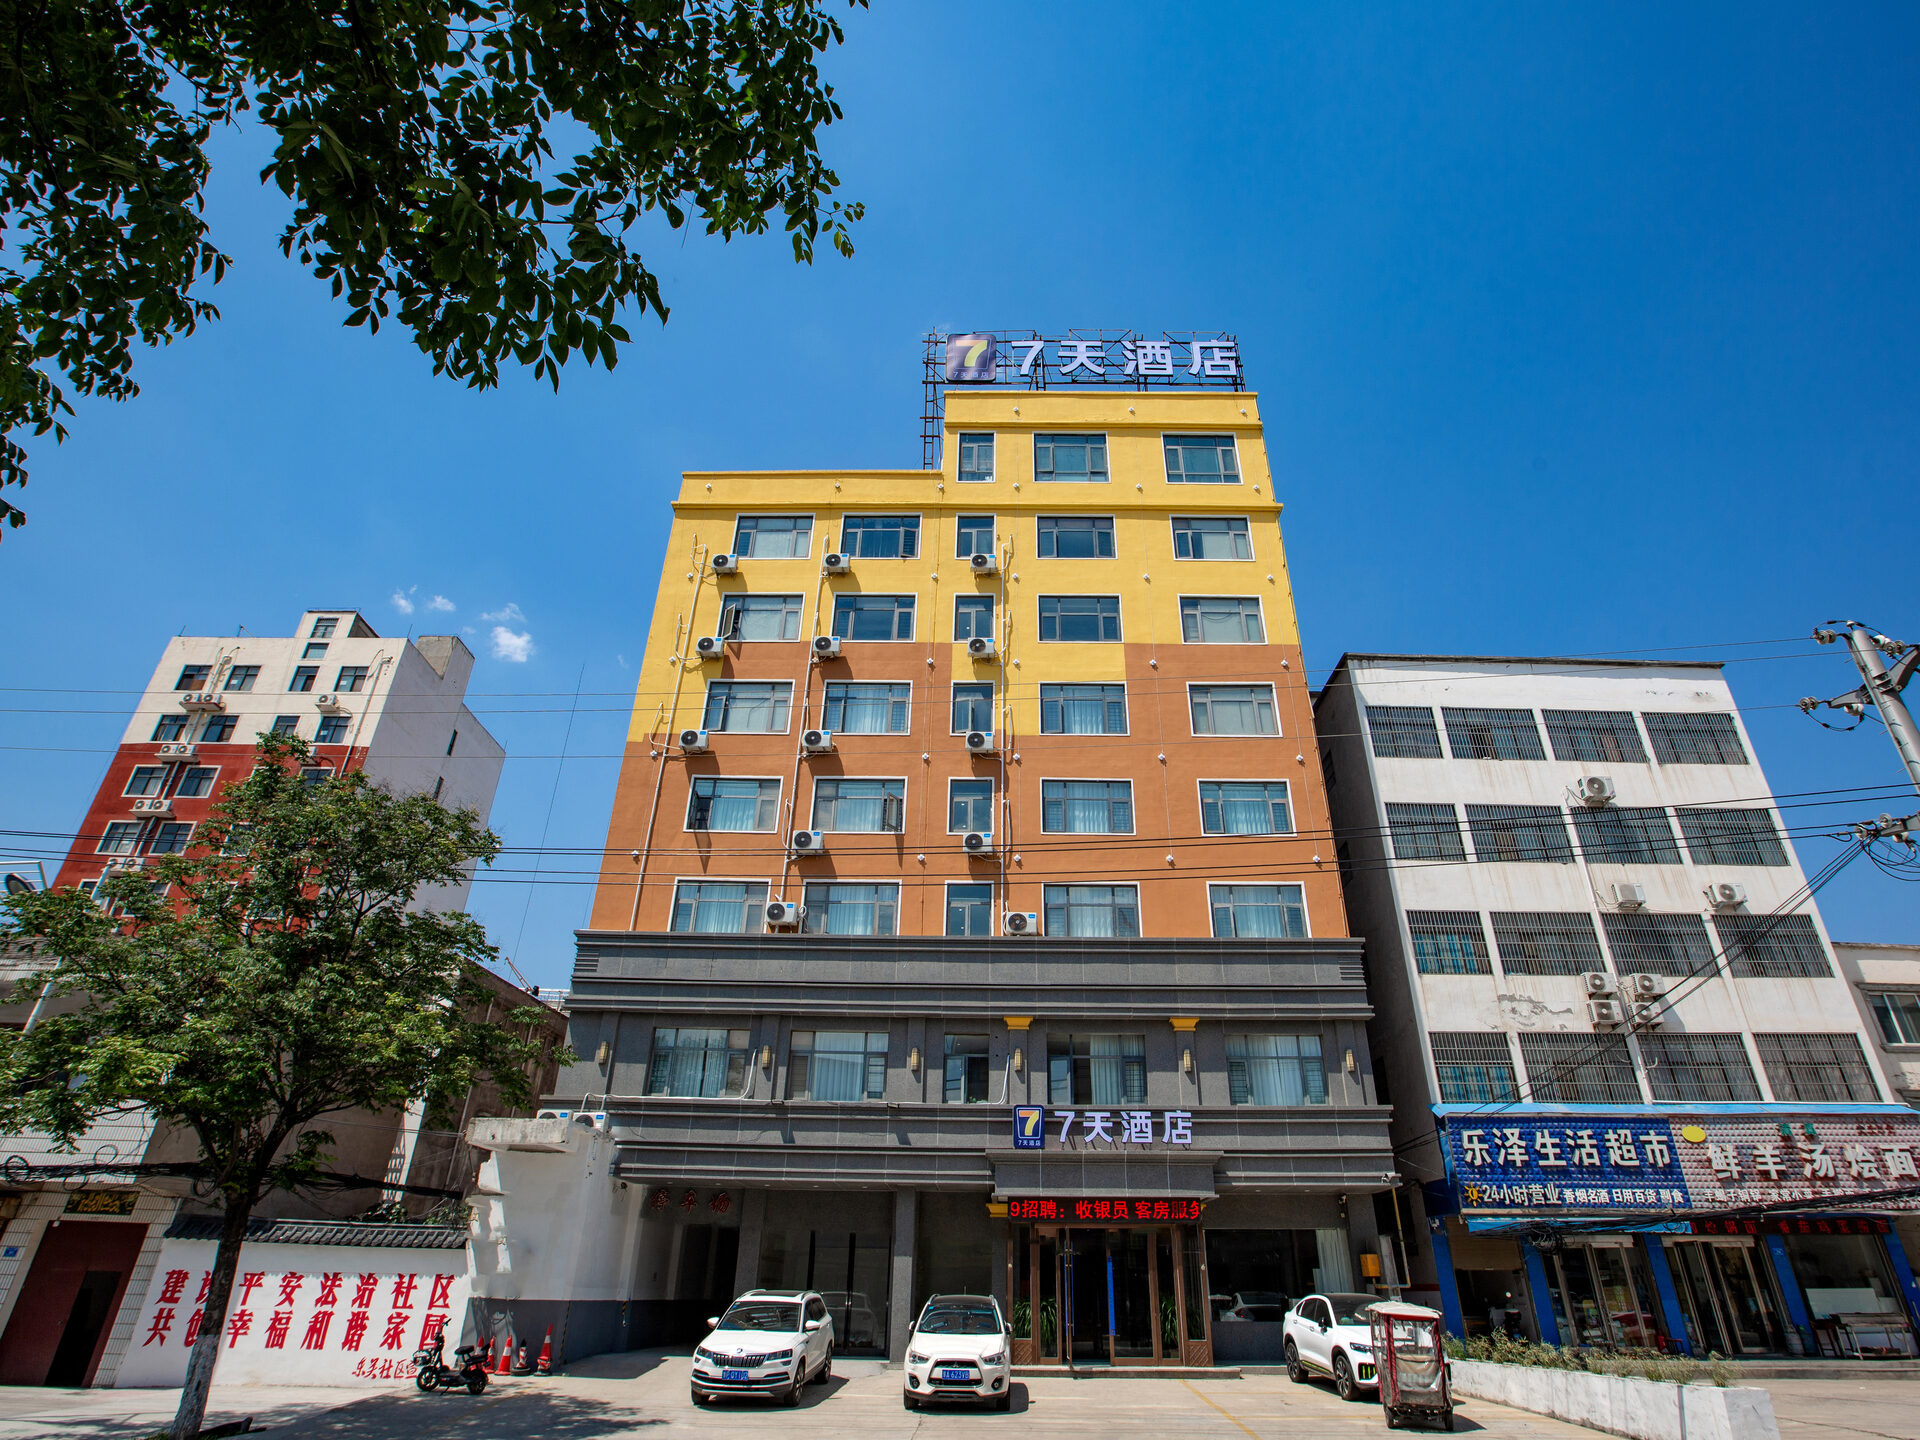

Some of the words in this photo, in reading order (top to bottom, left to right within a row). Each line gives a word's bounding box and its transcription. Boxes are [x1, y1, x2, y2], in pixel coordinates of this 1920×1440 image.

[955, 339, 988, 367] 7
[1011, 340, 1238, 377] 7天酒店
[1019, 1110, 1039, 1136] 7
[1054, 1110, 1193, 1144] 7天酒店
[1461, 1127, 1671, 1169] 乐泽生活超市
[1708, 1143, 1920, 1181] 鲜羊汤烩面
[1482, 1183, 1562, 1207] 24小时营业
[1563, 1188, 1610, 1204] 香烟名酒
[1612, 1188, 1657, 1204] 日用百货
